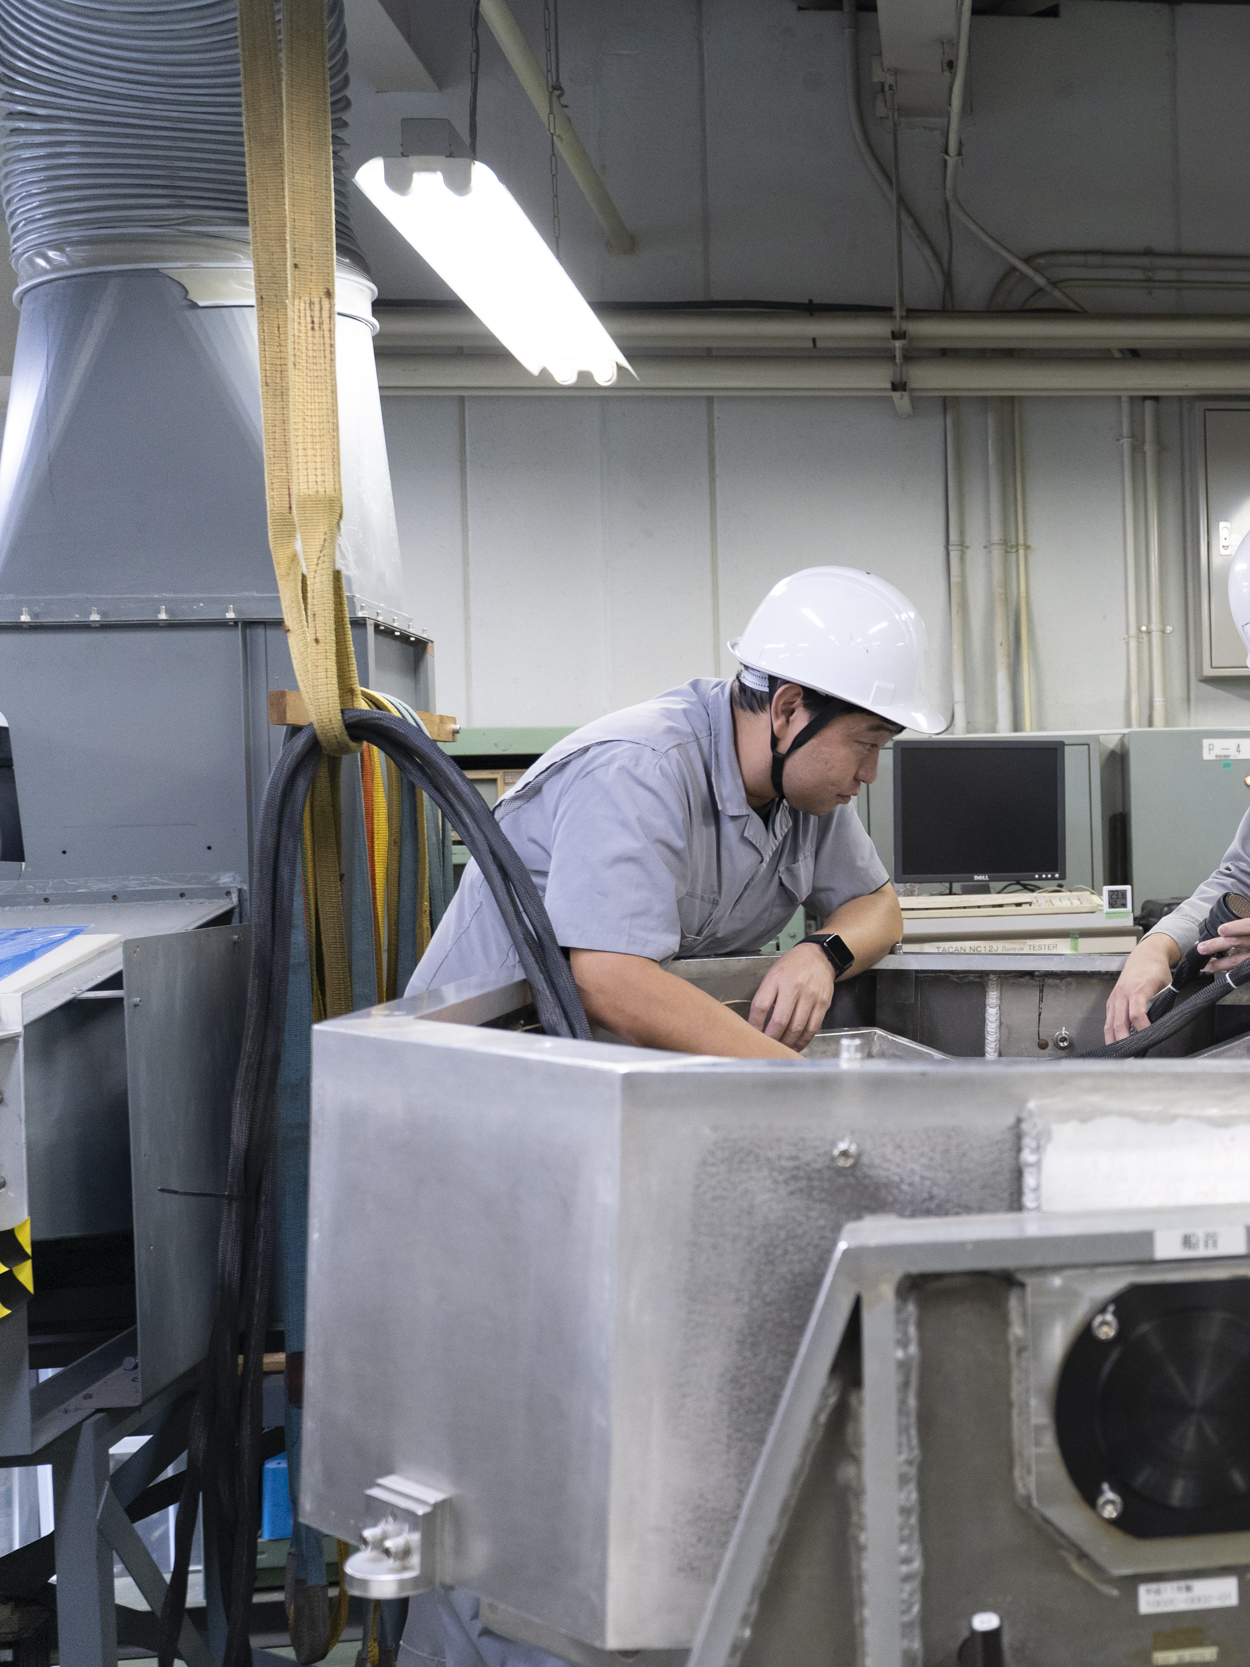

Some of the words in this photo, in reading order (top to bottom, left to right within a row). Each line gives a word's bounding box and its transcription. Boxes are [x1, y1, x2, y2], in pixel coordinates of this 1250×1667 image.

[936, 945, 967, 954] TACAN
[968, 944, 999, 954] NC12J
[1028, 943, 1059, 953] TESTER
